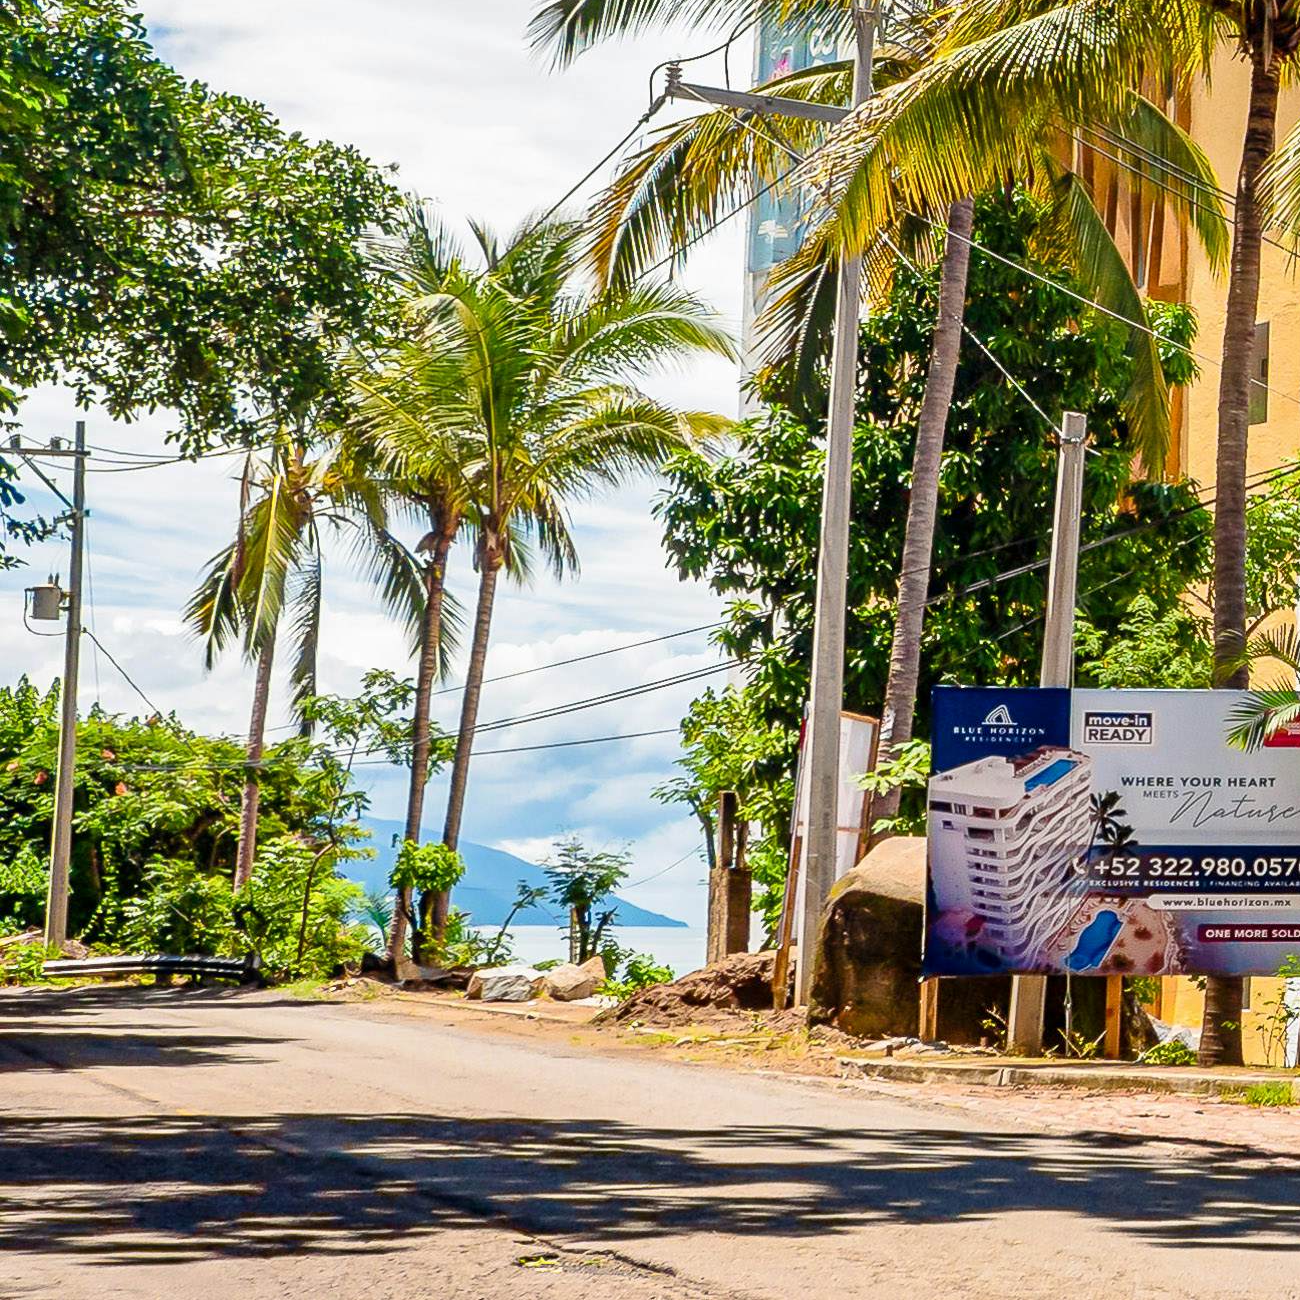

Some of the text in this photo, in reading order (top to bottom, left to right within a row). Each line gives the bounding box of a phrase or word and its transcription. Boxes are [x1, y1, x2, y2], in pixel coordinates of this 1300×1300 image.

[1088, 714, 1148, 726] move-in
[953, 726, 1046, 735] BLUE HORIZON
[1088, 728, 1147, 741] READY
[1121, 777, 1276, 787] WHERE YOUR HEART
[1143, 790, 1179, 799] MEETS
[1094, 857, 1140, 876] +52
[1163, 897, 1292, 907] www.bluehorizon.mx
[1205, 929, 1231, 938] ONE
[1234, 929, 1268, 938] MORE
